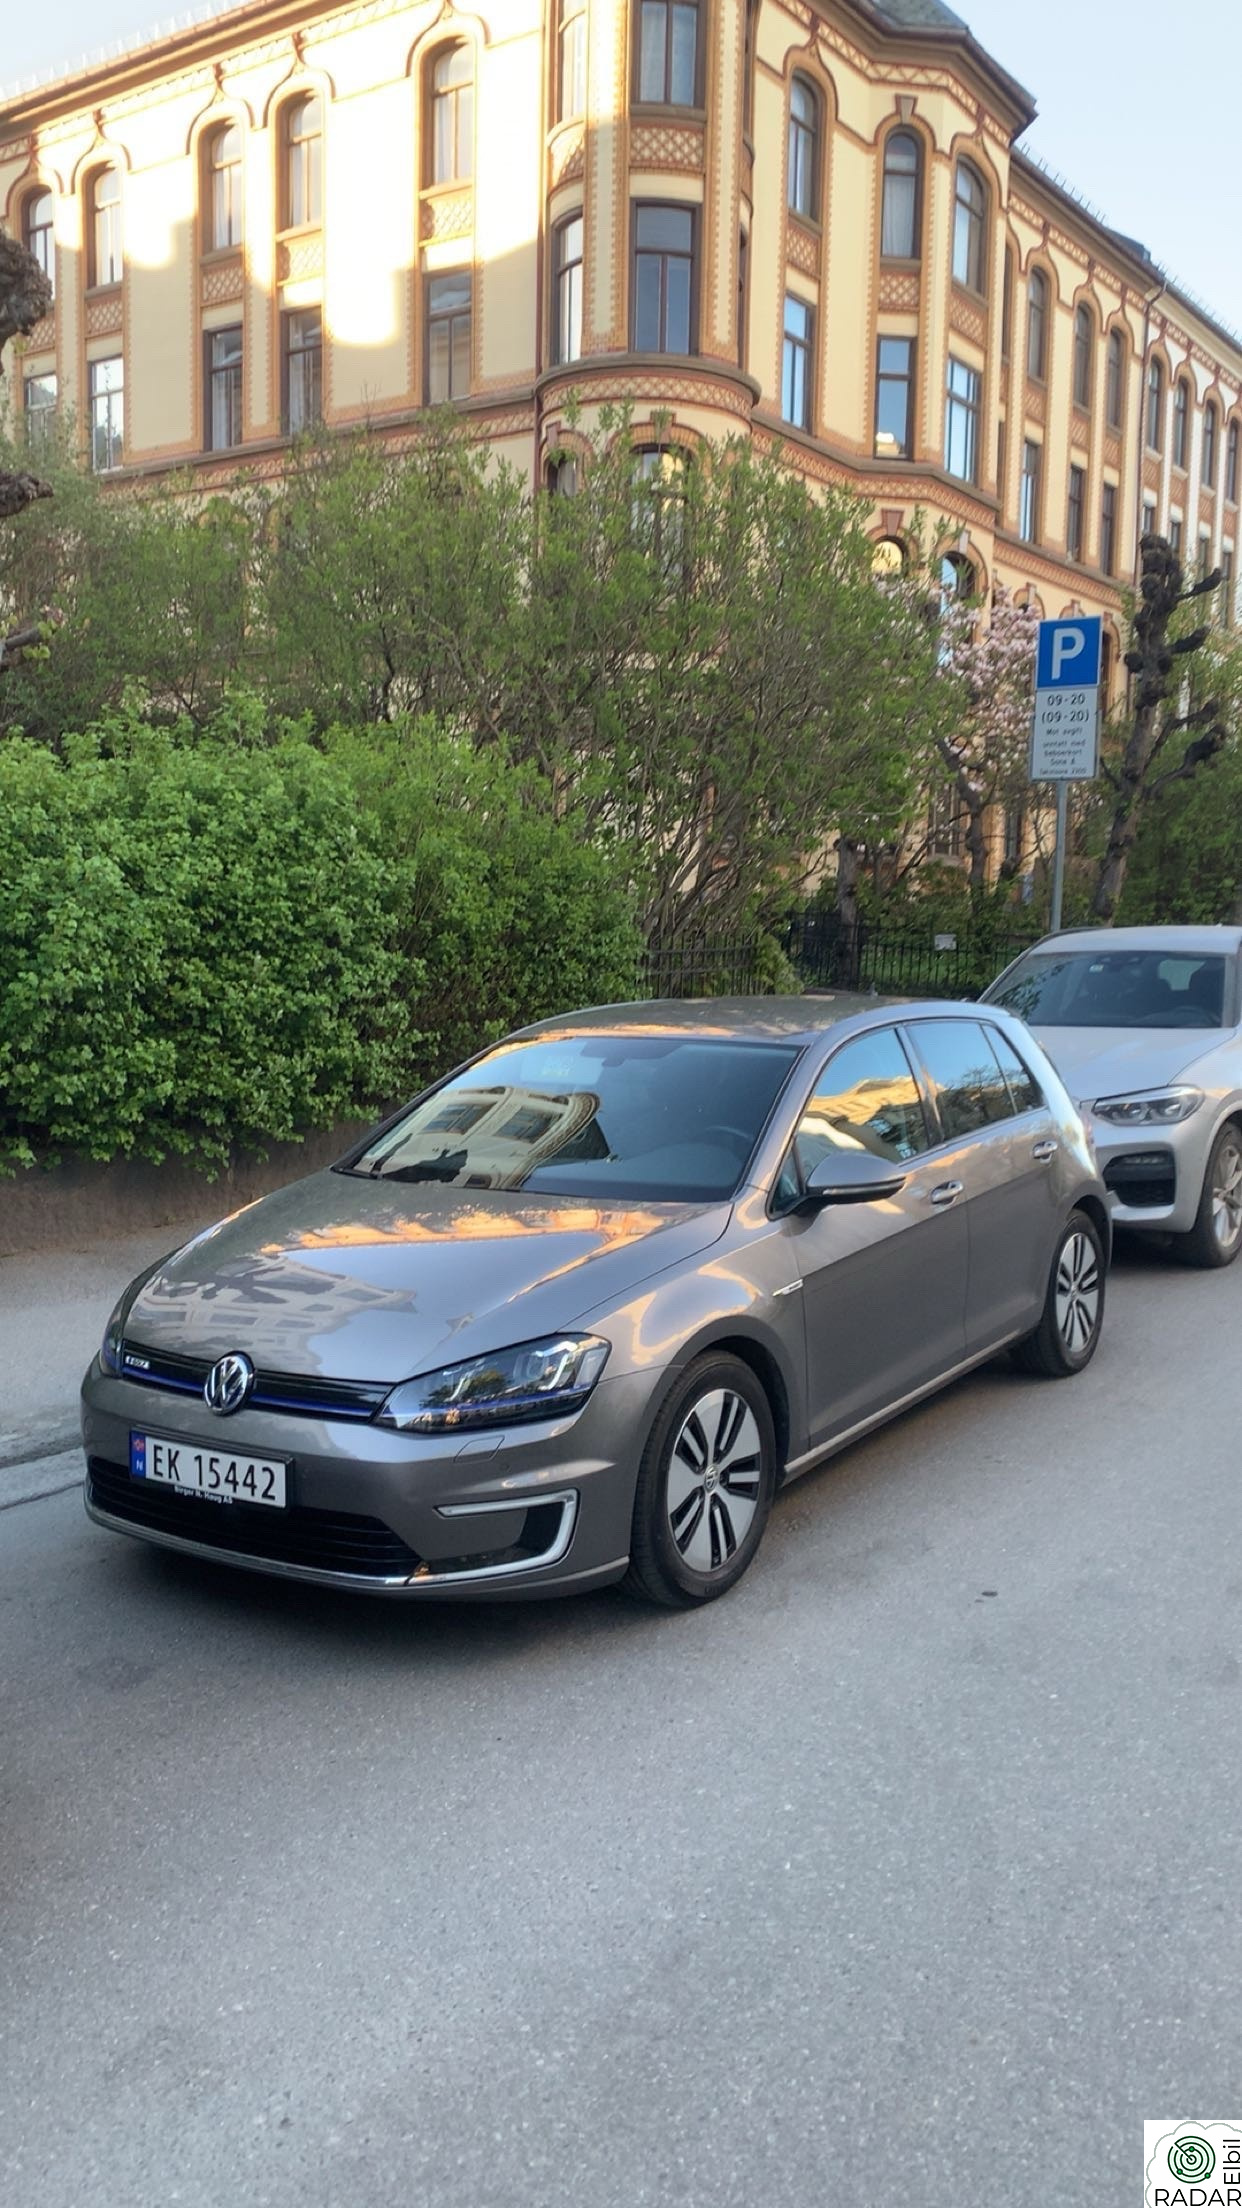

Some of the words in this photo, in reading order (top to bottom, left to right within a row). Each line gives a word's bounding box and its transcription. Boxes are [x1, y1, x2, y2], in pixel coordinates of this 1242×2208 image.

[1051, 627, 1086, 680] P
[152, 1444, 181, 1481] EK
[193, 1454, 276, 1501] 15442
